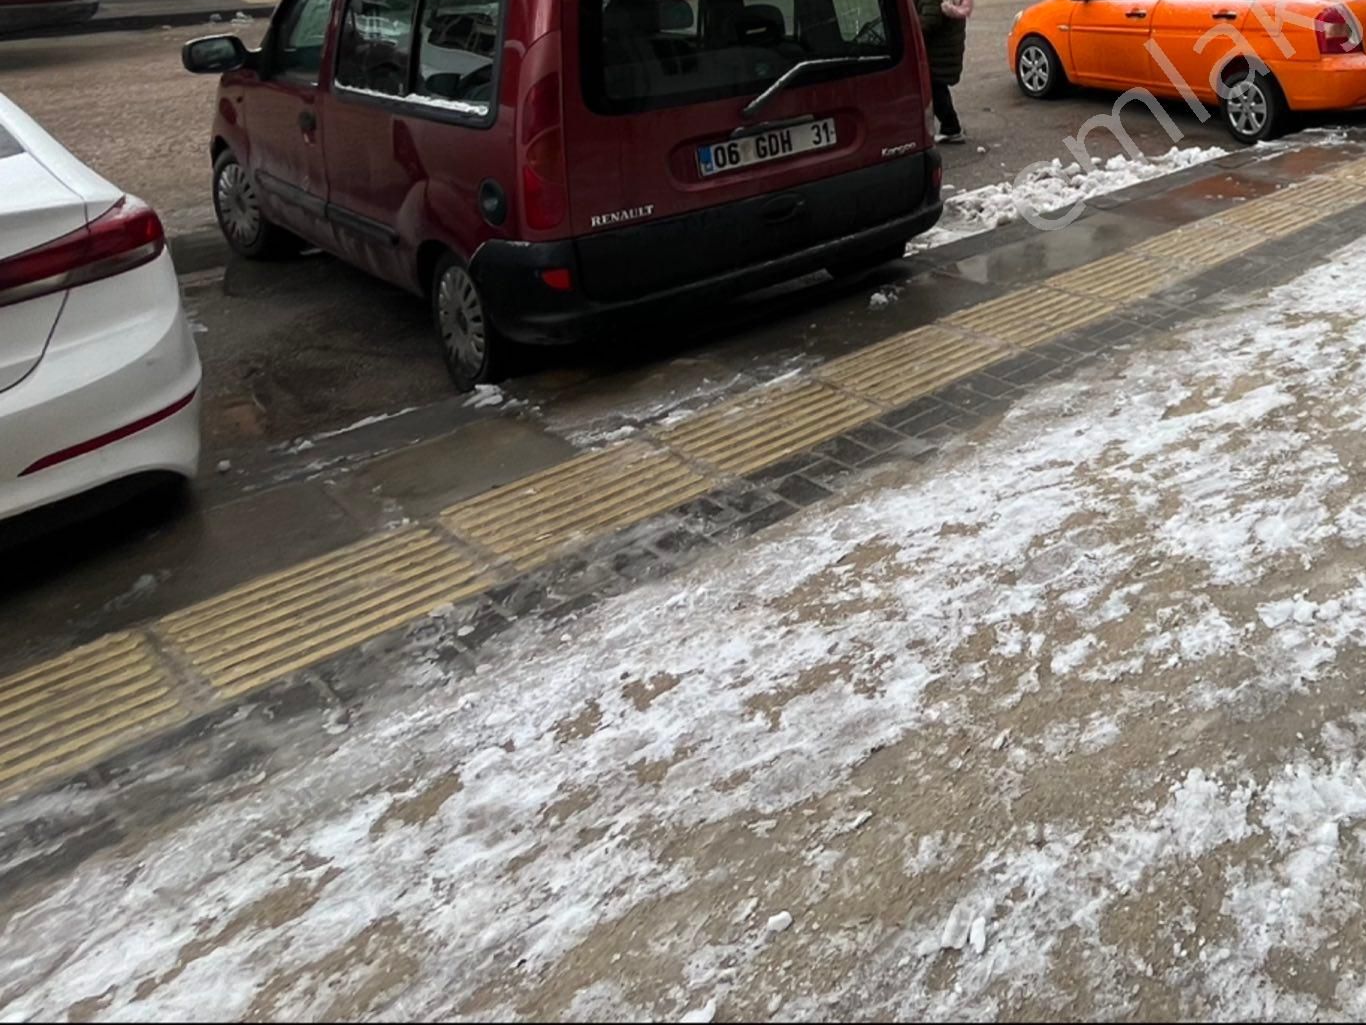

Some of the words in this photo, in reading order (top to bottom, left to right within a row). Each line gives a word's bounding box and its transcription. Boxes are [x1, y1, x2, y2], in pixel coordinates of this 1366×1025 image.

[714, 142, 741, 168] 06
[755, 130, 793, 159] GDH
[811, 121, 831, 145] 31
[591, 204, 655, 227] RENAULT
